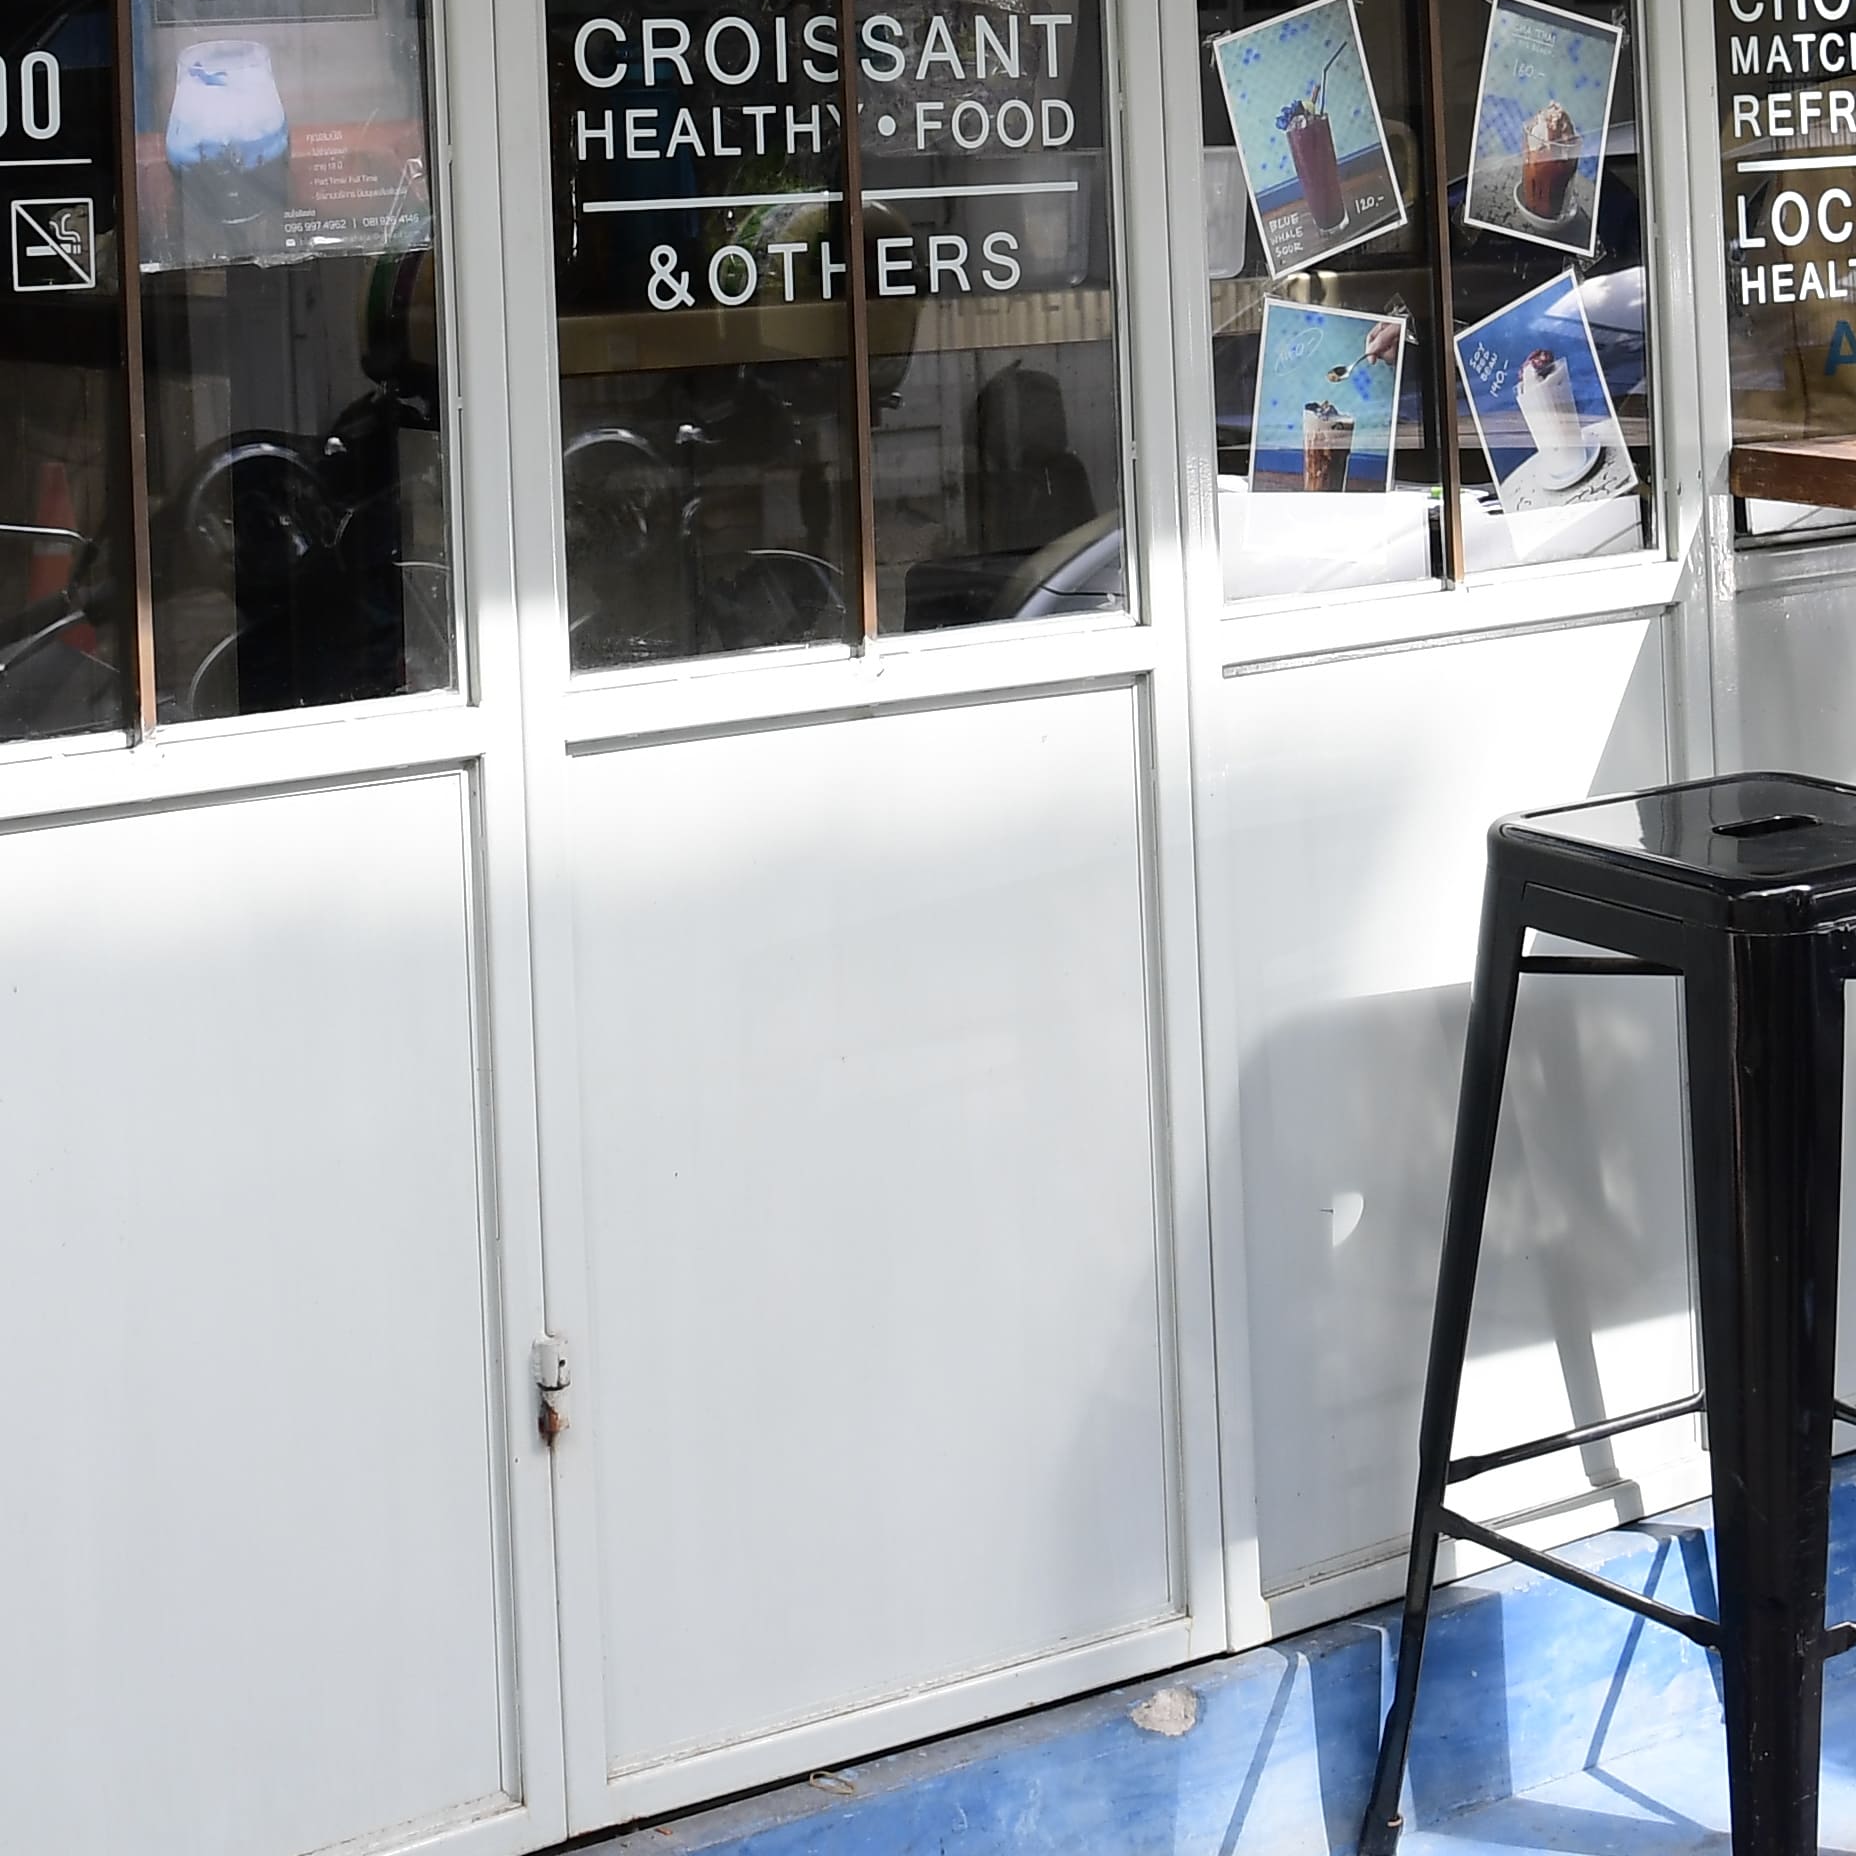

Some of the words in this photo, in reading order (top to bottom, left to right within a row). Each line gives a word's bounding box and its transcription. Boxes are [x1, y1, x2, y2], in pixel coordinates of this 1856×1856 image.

[572, 13, 1074, 89] CROISSANT
[915, 98, 1076, 152] FOOD
[1268, 212, 1300, 233] BLUE
[1354, 195, 1385, 214] 120.-
[1270, 226, 1304, 246] WHALE
[646, 231, 1022, 313] &OTHERS
[1490, 360, 1509, 398] 140.-
